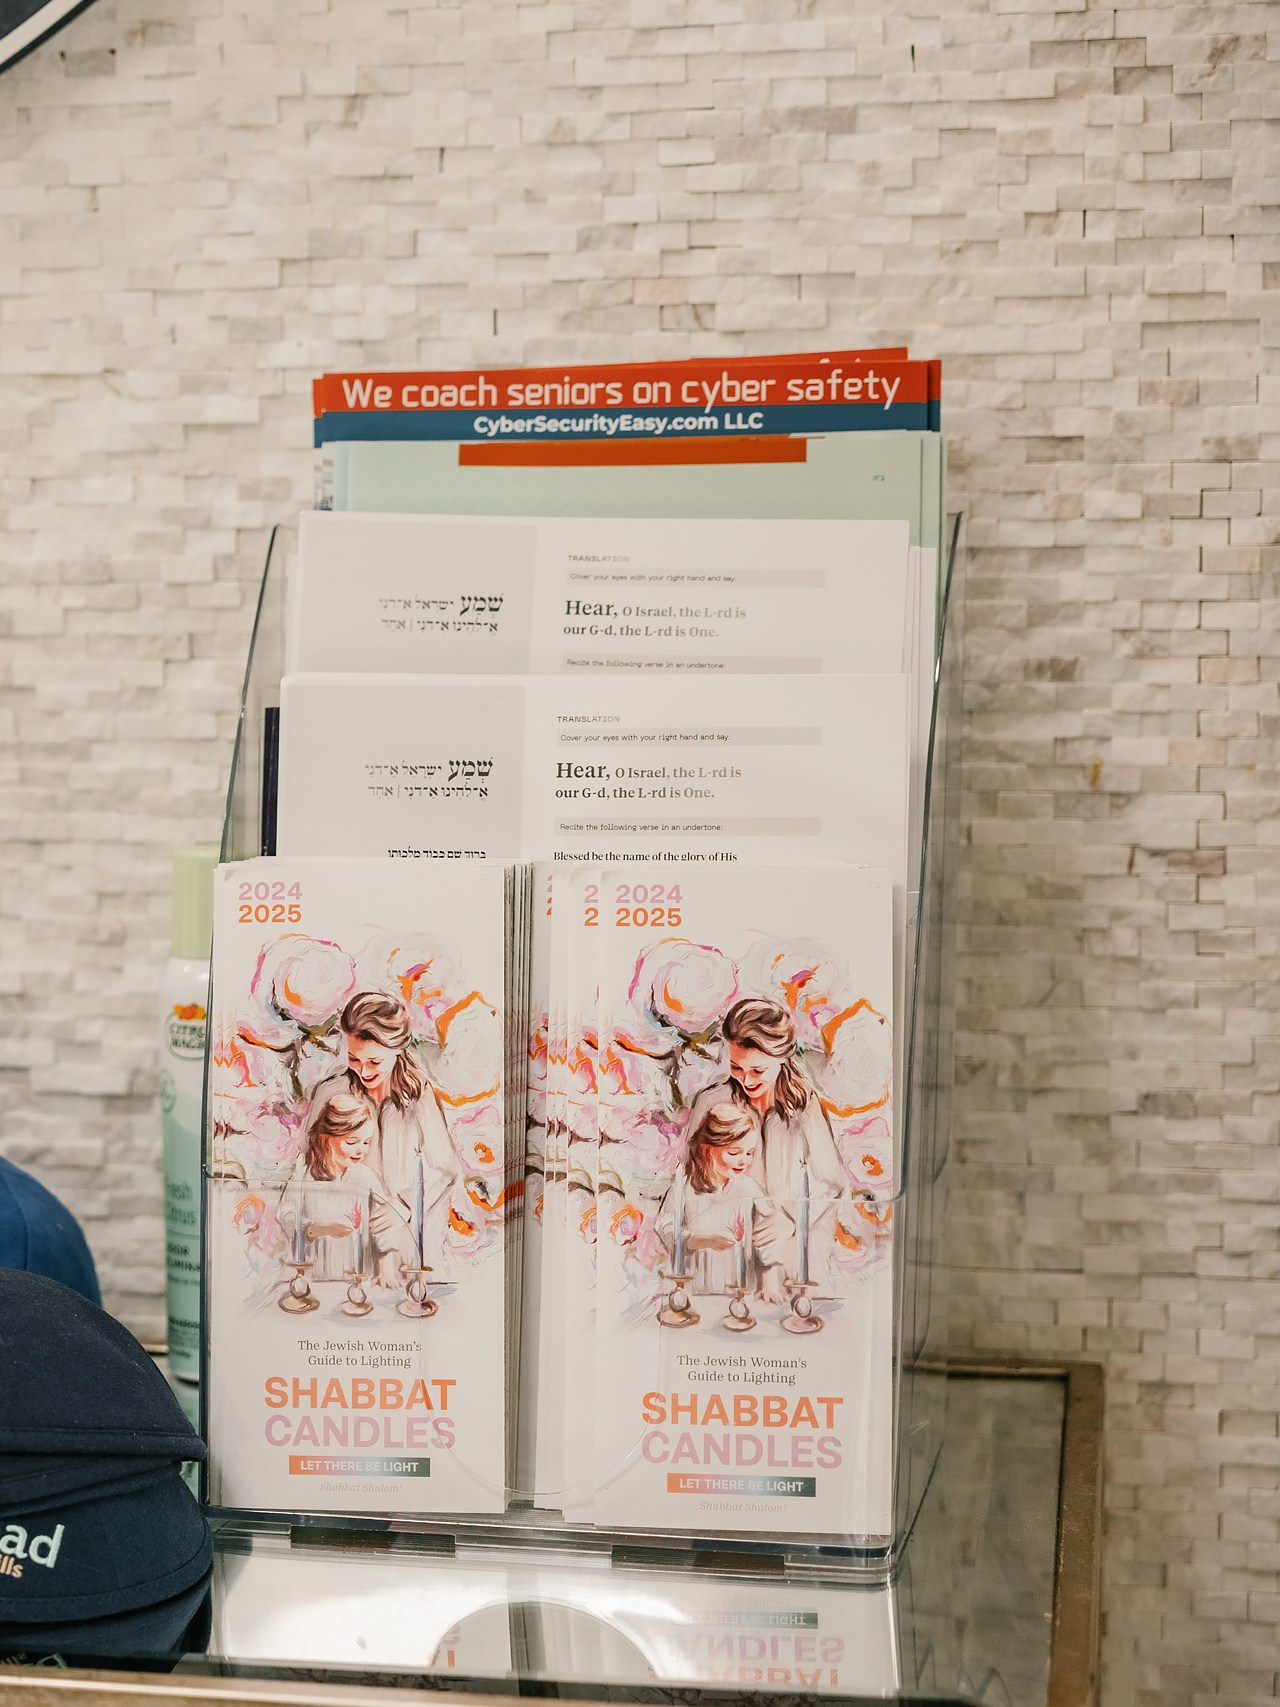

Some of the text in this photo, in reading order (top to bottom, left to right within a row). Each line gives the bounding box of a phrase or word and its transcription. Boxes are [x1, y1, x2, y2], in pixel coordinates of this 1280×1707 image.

[341, 368, 902, 414] We coach seniors on cyber safety
[473, 412, 764, 437] CyberSecurityEasy.com LLC
[570, 573, 591, 581] Cover
[630, 573, 646, 581] with
[666, 574, 685, 583] right
[686, 574, 706, 582] hand
[722, 575, 737, 583] say:
[564, 600, 747, 619] Hear, O Israel, the L-rd is
[563, 625, 720, 638] our G-d, the L-rd is One.
[567, 659, 590, 667] Recite
[592, 659, 604, 667] the
[606, 660, 642, 669] following
[686, 661, 726, 669] undertone:
[584, 735, 600, 743] your
[602, 735, 619, 743] eyes
[621, 733, 638, 741] with
[640, 735, 656, 743] your
[658, 734, 677, 742] right
[679, 733, 698, 741] hand
[700, 733, 715, 741] and
[716, 734, 731, 742] say:
[556, 762, 742, 781] Hear, O Israel, the L-rd is
[555, 787, 715, 800] our G-d, the L-rd is One.
[560, 823, 584, 831] Recite
[586, 823, 598, 831] the
[600, 823, 637, 832] following
[661, 823, 669, 831] in
[682, 823, 723, 831] undertone:
[553, 851, 738, 862] Blessed be the name of the glory of His
[238, 881, 303, 900] 2024
[615, 884, 683, 904] 2024
[238, 904, 302, 923] 2025
[615, 907, 683, 927] 2025
[297, 1340, 422, 1352] The Jewish Woman's
[308, 1355, 412, 1369] Guide to Lighting
[677, 1355, 807, 1368] The Jewish Woman's
[687, 1371, 796, 1386] Guide to Lighting
[264, 1376, 457, 1411] SHABBAT
[641, 1391, 844, 1430] SHABBAT
[264, 1414, 456, 1449] CANDLES
[641, 1430, 843, 1470] CANDLES
[300, 1460, 419, 1472] LET THERE BE LIGHT
[320, 1482, 403, 1493] Shabbat Shalom!
[679, 1478, 804, 1492] LET THERE BE LIGHT
[699, 1501, 787, 1513] Shabbat Shalom!
